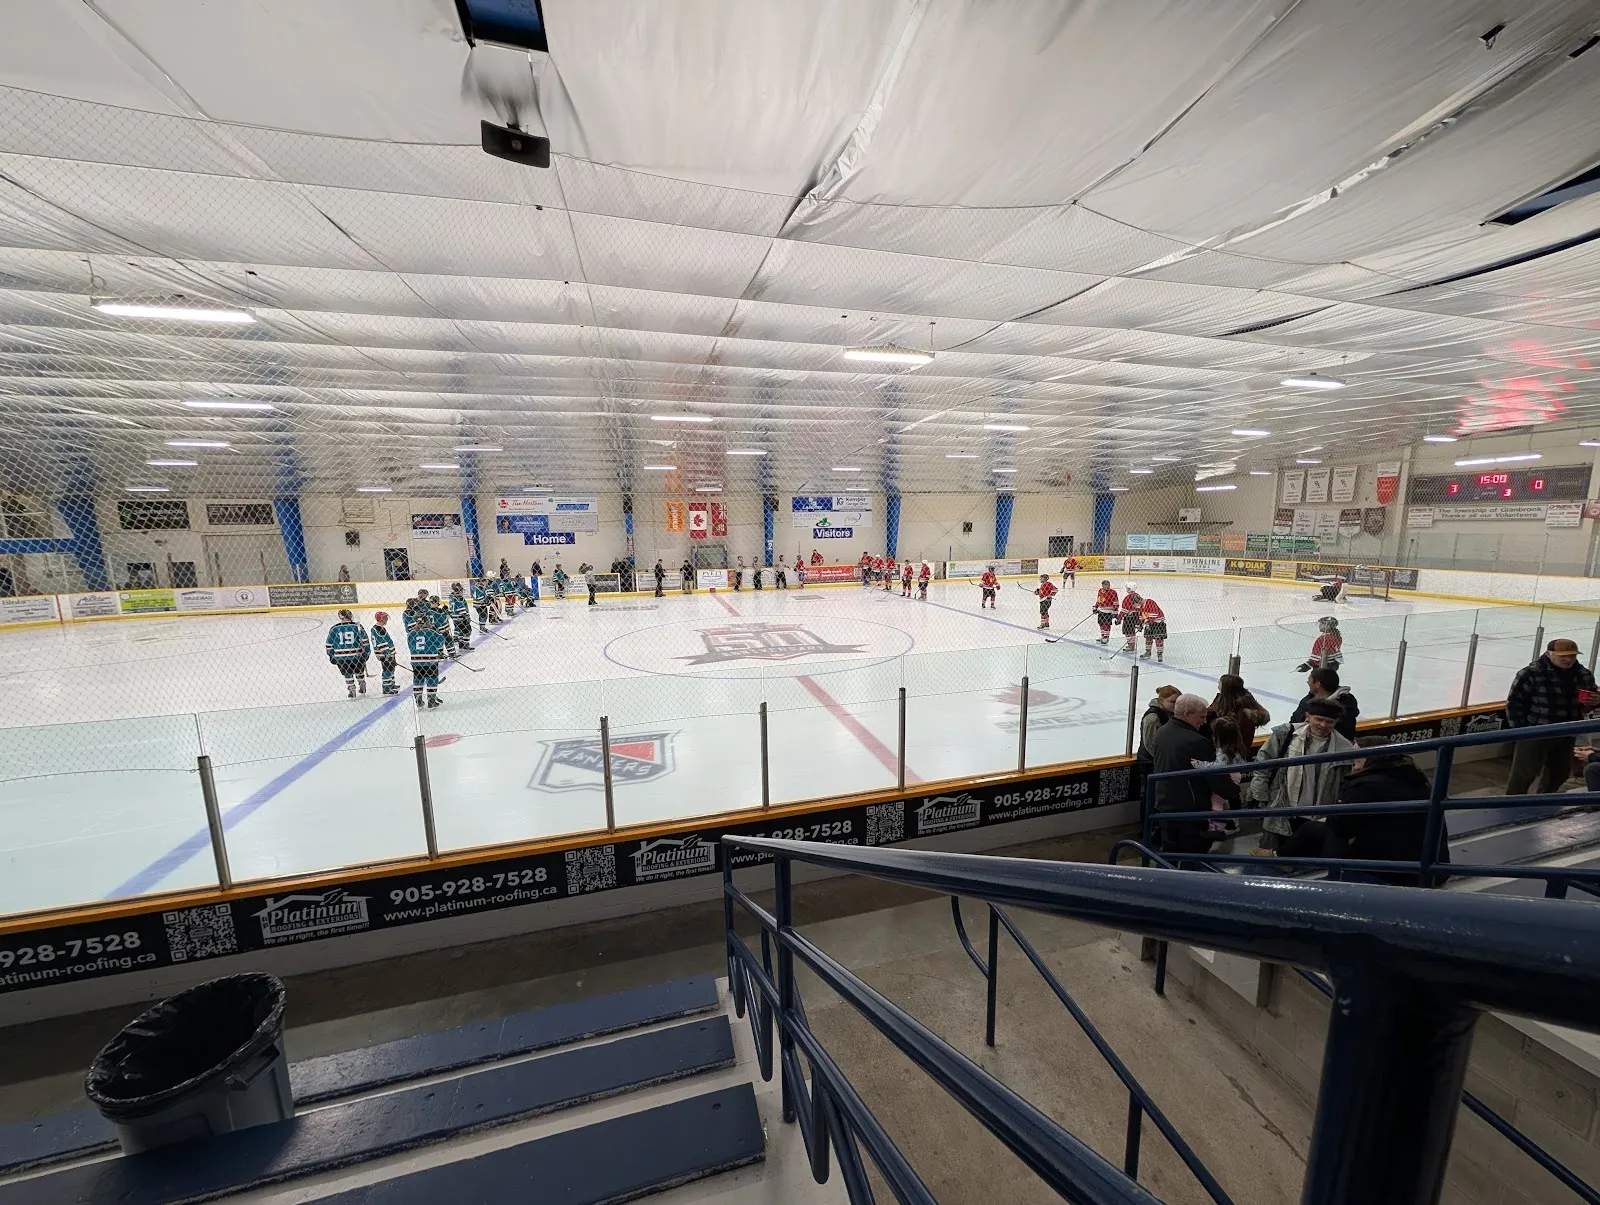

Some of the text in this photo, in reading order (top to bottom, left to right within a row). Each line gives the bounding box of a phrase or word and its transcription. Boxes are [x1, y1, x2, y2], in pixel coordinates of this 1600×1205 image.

[1481, 473, 1508, 485] 15:00
[1534, 479, 1544, 490] 0
[1451, 484, 1458, 493] 3
[1503, 488, 1512, 497] 3
[523, 499, 544, 507] Hortons
[533, 535, 567, 544] Home
[816, 529, 851, 538] Visitors
[1182, 558, 1221, 566] TOWNLINE
[338, 631, 355, 645] 19
[415, 635, 426, 651] 2
[994, 782, 1089, 808] 905-928-7528
[923, 803, 976, 820] Platinum
[988, 797, 1093, 821] www.platinum-roofing.ca
[642, 846, 708, 865] Platinum
[642, 863, 669, 872] ROOFING
[675, 856, 708, 866] EXTERIORS
[389, 867, 548, 906] 905-928-7528
[383, 885, 557, 922] www.platinum-roofing.ca
[270, 901, 358, 926] Platinum
[270, 912, 359, 934] ROOFING & EXTERIORS
[264, 937, 276, 945] We
[277, 935, 288, 944] do
[295, 931, 316, 942] right,
[316, 929, 329, 937] the
[330, 926, 345, 935] first
